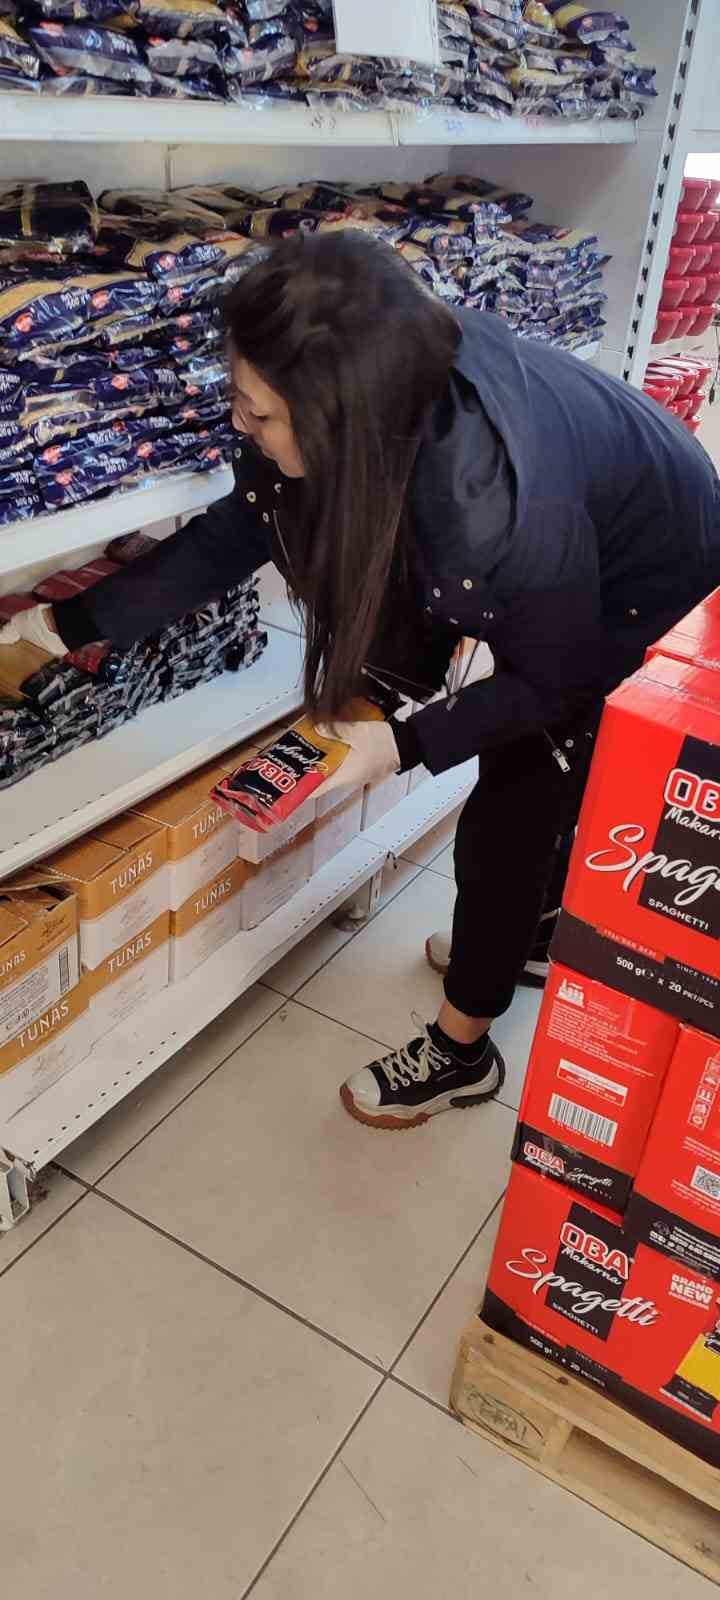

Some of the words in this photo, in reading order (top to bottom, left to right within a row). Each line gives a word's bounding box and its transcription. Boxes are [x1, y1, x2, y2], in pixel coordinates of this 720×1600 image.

[192, 804, 224, 839] TUNA
[664, 806, 720, 841] Makar
[111, 851, 153, 895] TUNAS
[194, 878, 232, 914] TUNAS
[647, 898, 709, 930] SPAGHETTI
[107, 931, 153, 974] TUNAS
[675, 963, 699, 977] SINCE
[616, 956, 634, 971] 500
[668, 981, 681, 993] 20
[18, 1001, 70, 1048] TUNAS
[523, 1141, 565, 1174] OBA
[560, 1221, 629, 1280] OBA
[561, 1246, 622, 1285] Makarna
[505, 1247, 658, 1327] Spagetti
[669, 1281, 713, 1305] NEW
[671, 1274, 714, 1295] BRAND
